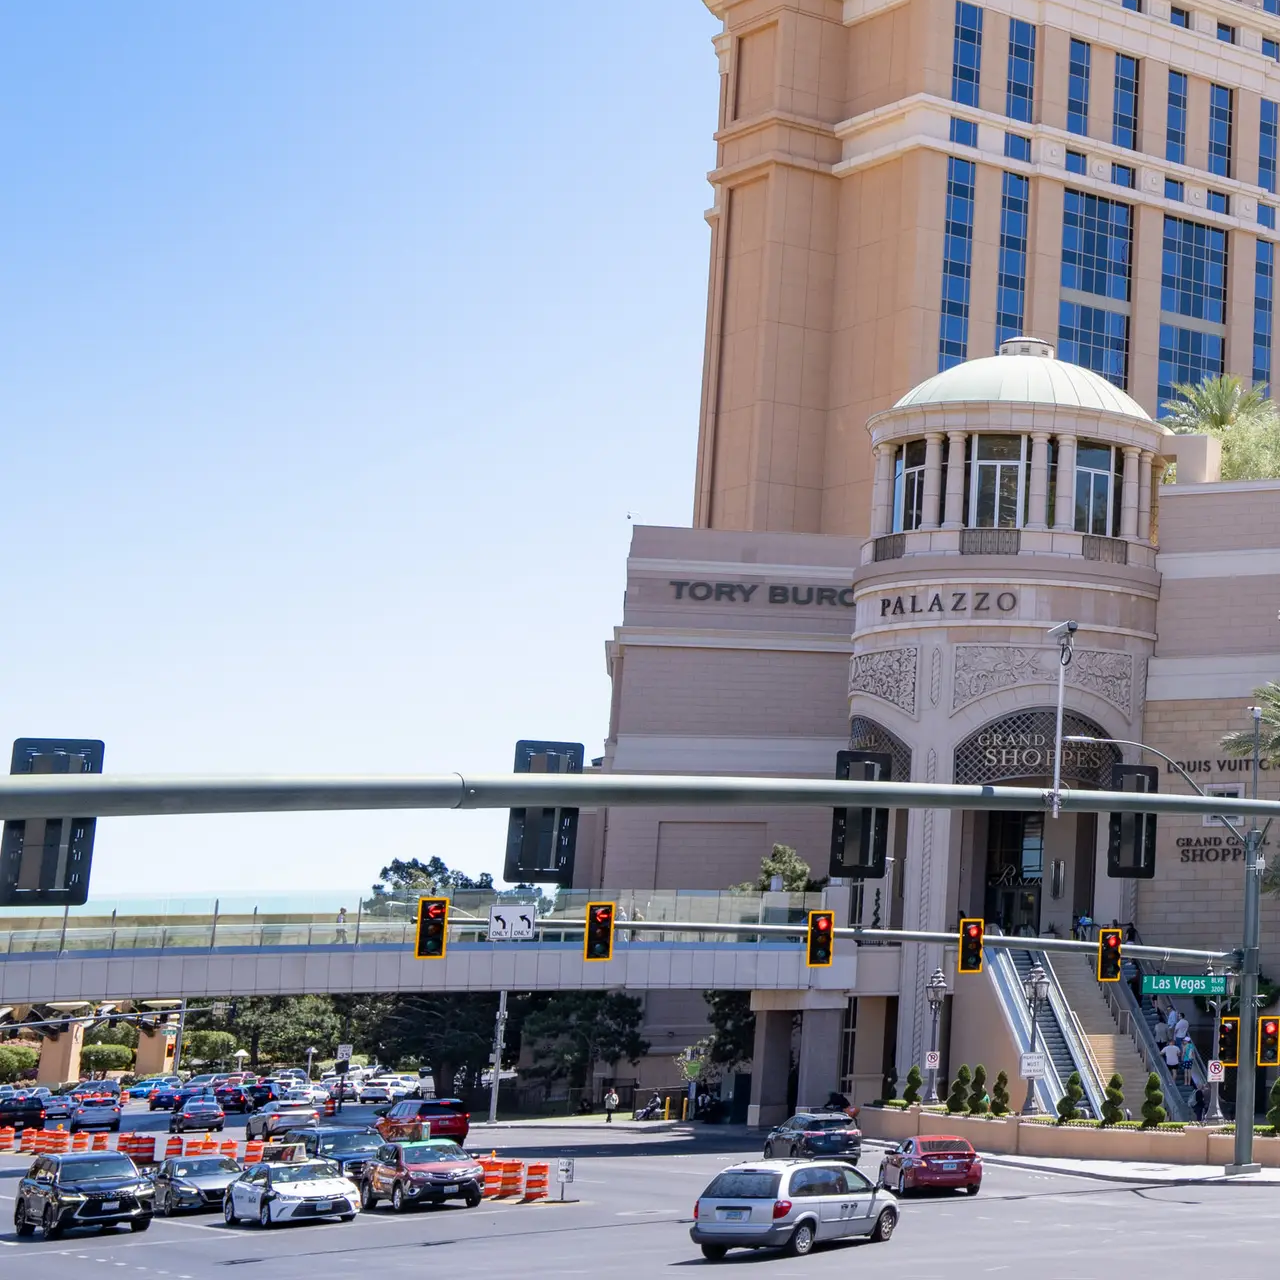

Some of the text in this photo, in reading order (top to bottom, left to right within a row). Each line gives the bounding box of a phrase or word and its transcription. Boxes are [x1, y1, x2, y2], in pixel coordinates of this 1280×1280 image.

[670, 581, 856, 607] TORY BURC
[880, 592, 1017, 616] PALAZZO
[978, 734, 1046, 746] GRAND
[985, 748, 1101, 768] SHOPPES
[1167, 760, 1212, 774] LOUIS
[1176, 836, 1271, 848] GRAND CAL
[1180, 848, 1246, 862] SHOPP
[1152, 976, 1171, 989] Las
[1174, 976, 1206, 993] Vegas
